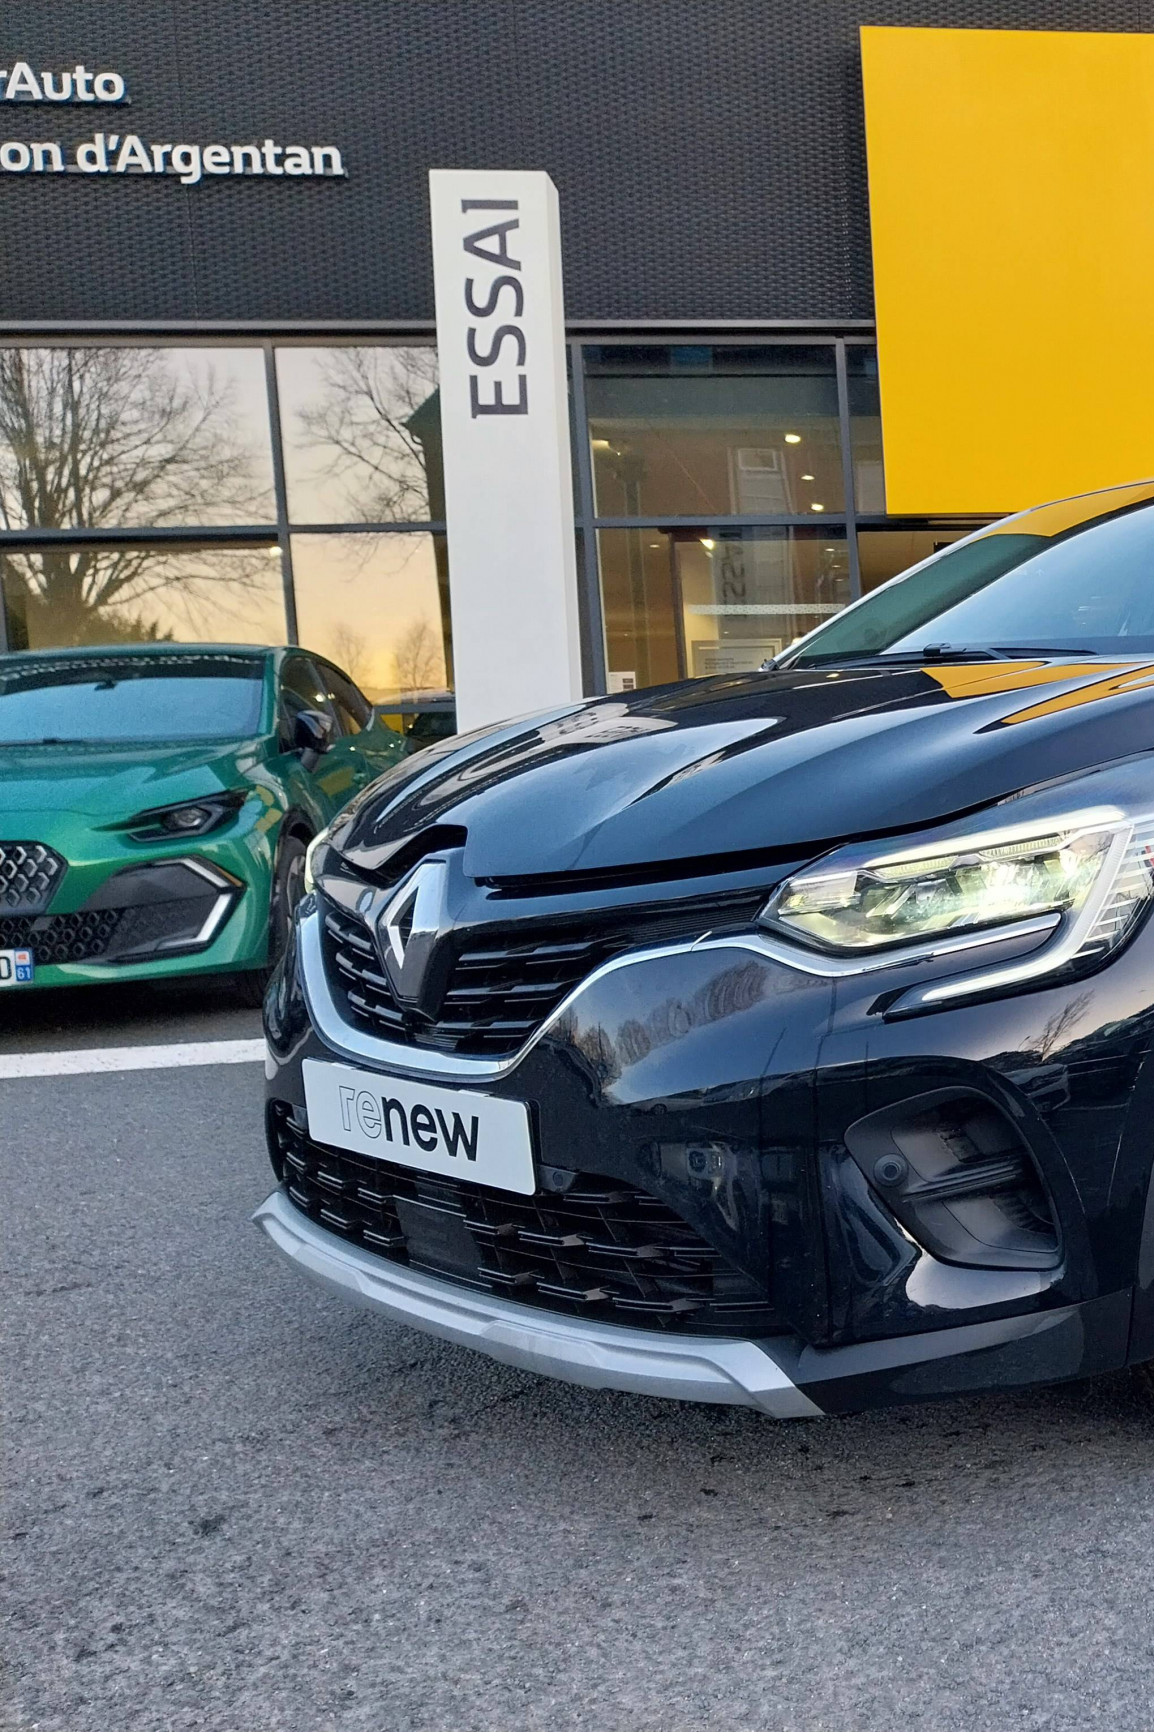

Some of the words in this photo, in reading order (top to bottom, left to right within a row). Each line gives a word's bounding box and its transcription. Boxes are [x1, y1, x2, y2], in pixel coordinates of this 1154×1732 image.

[76, 133, 344, 184] d'Argentan
[460, 198, 529, 419] ESSAI
[16, 966, 31, 980] 61
[339, 1085, 479, 1162] renew
